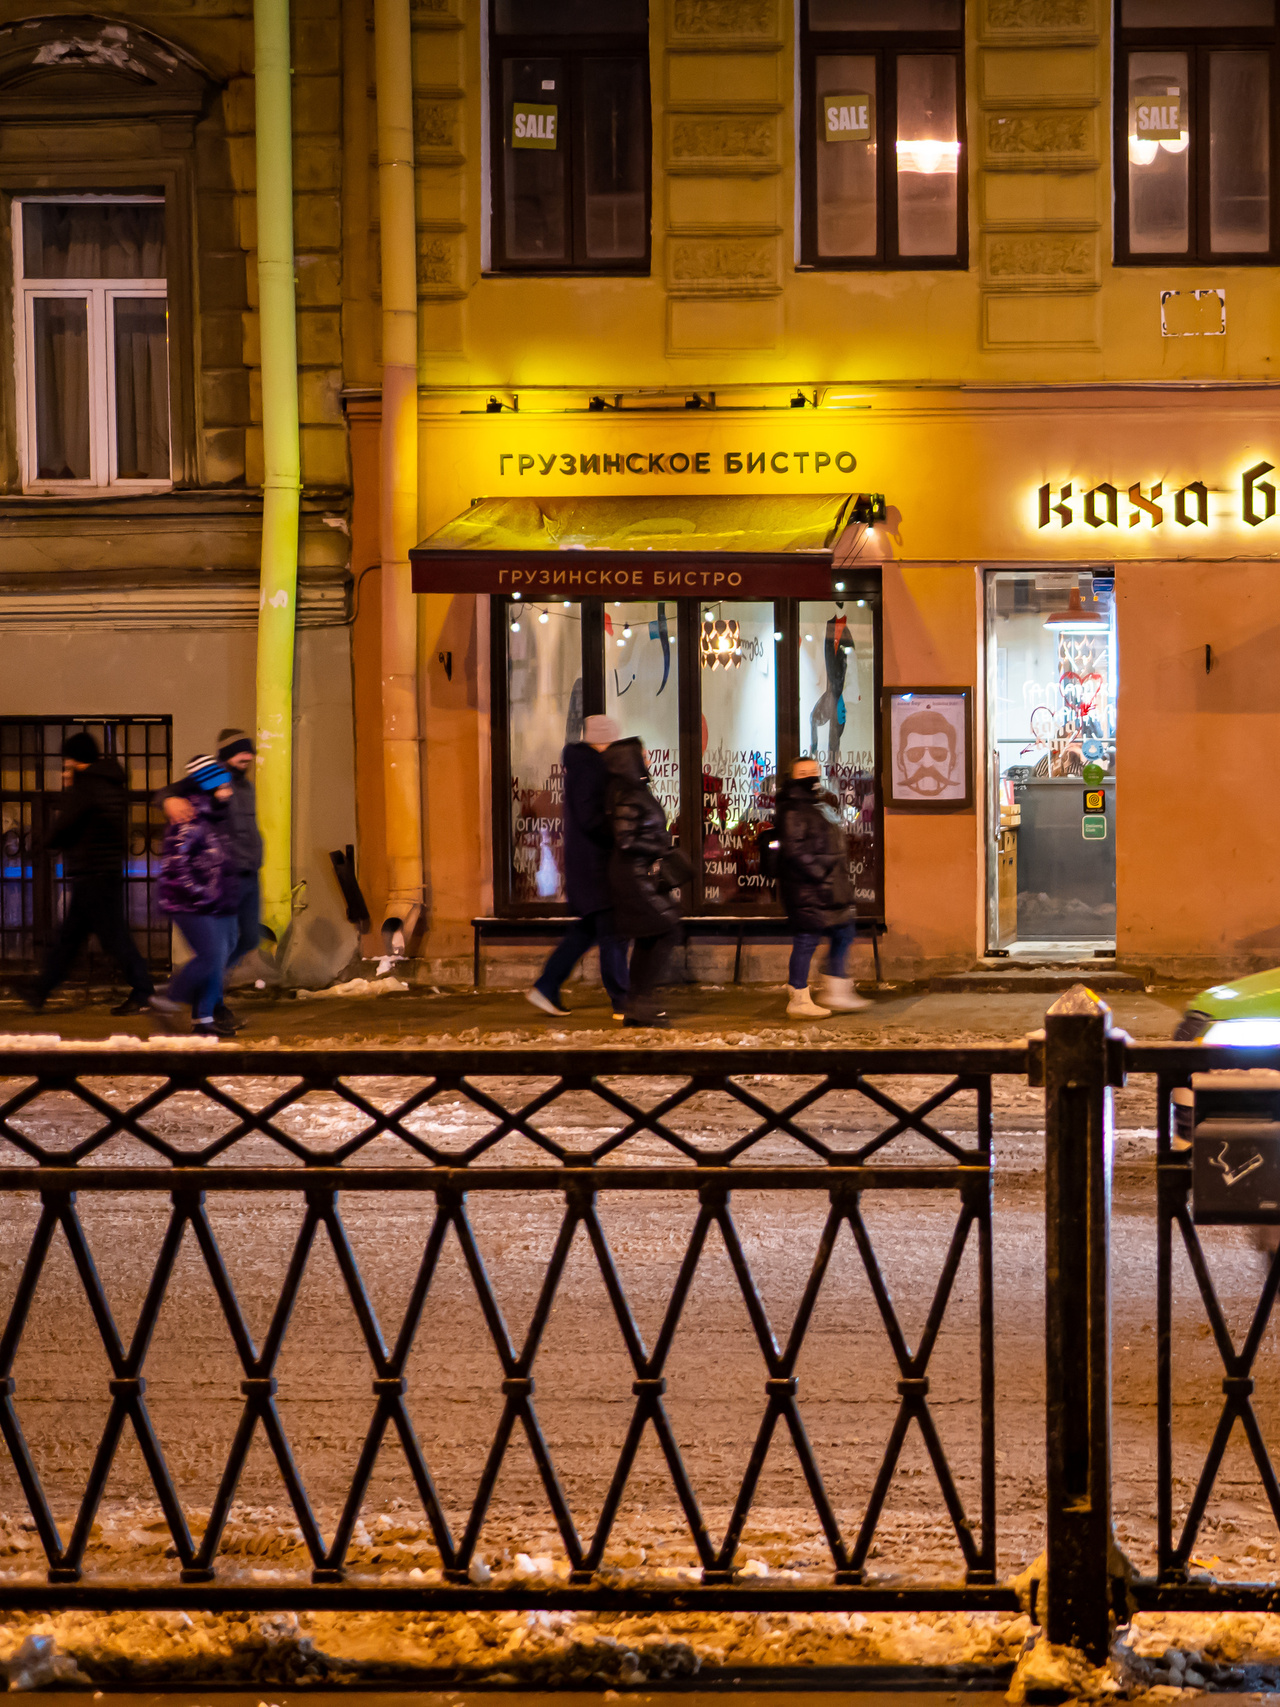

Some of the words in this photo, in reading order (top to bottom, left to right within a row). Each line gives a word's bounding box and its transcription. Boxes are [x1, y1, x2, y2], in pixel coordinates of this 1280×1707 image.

[515, 113, 555, 139] SALE
[827, 105, 868, 132] SALE
[1138, 106, 1178, 130] SALE
[499, 451, 711, 476] ГРУЗИНСКОЕ
[724, 450, 857, 475] БИСТРО
[498, 569, 643, 586] ГРУЗИНСКОЕ
[652, 570, 742, 586] БИСТРО
